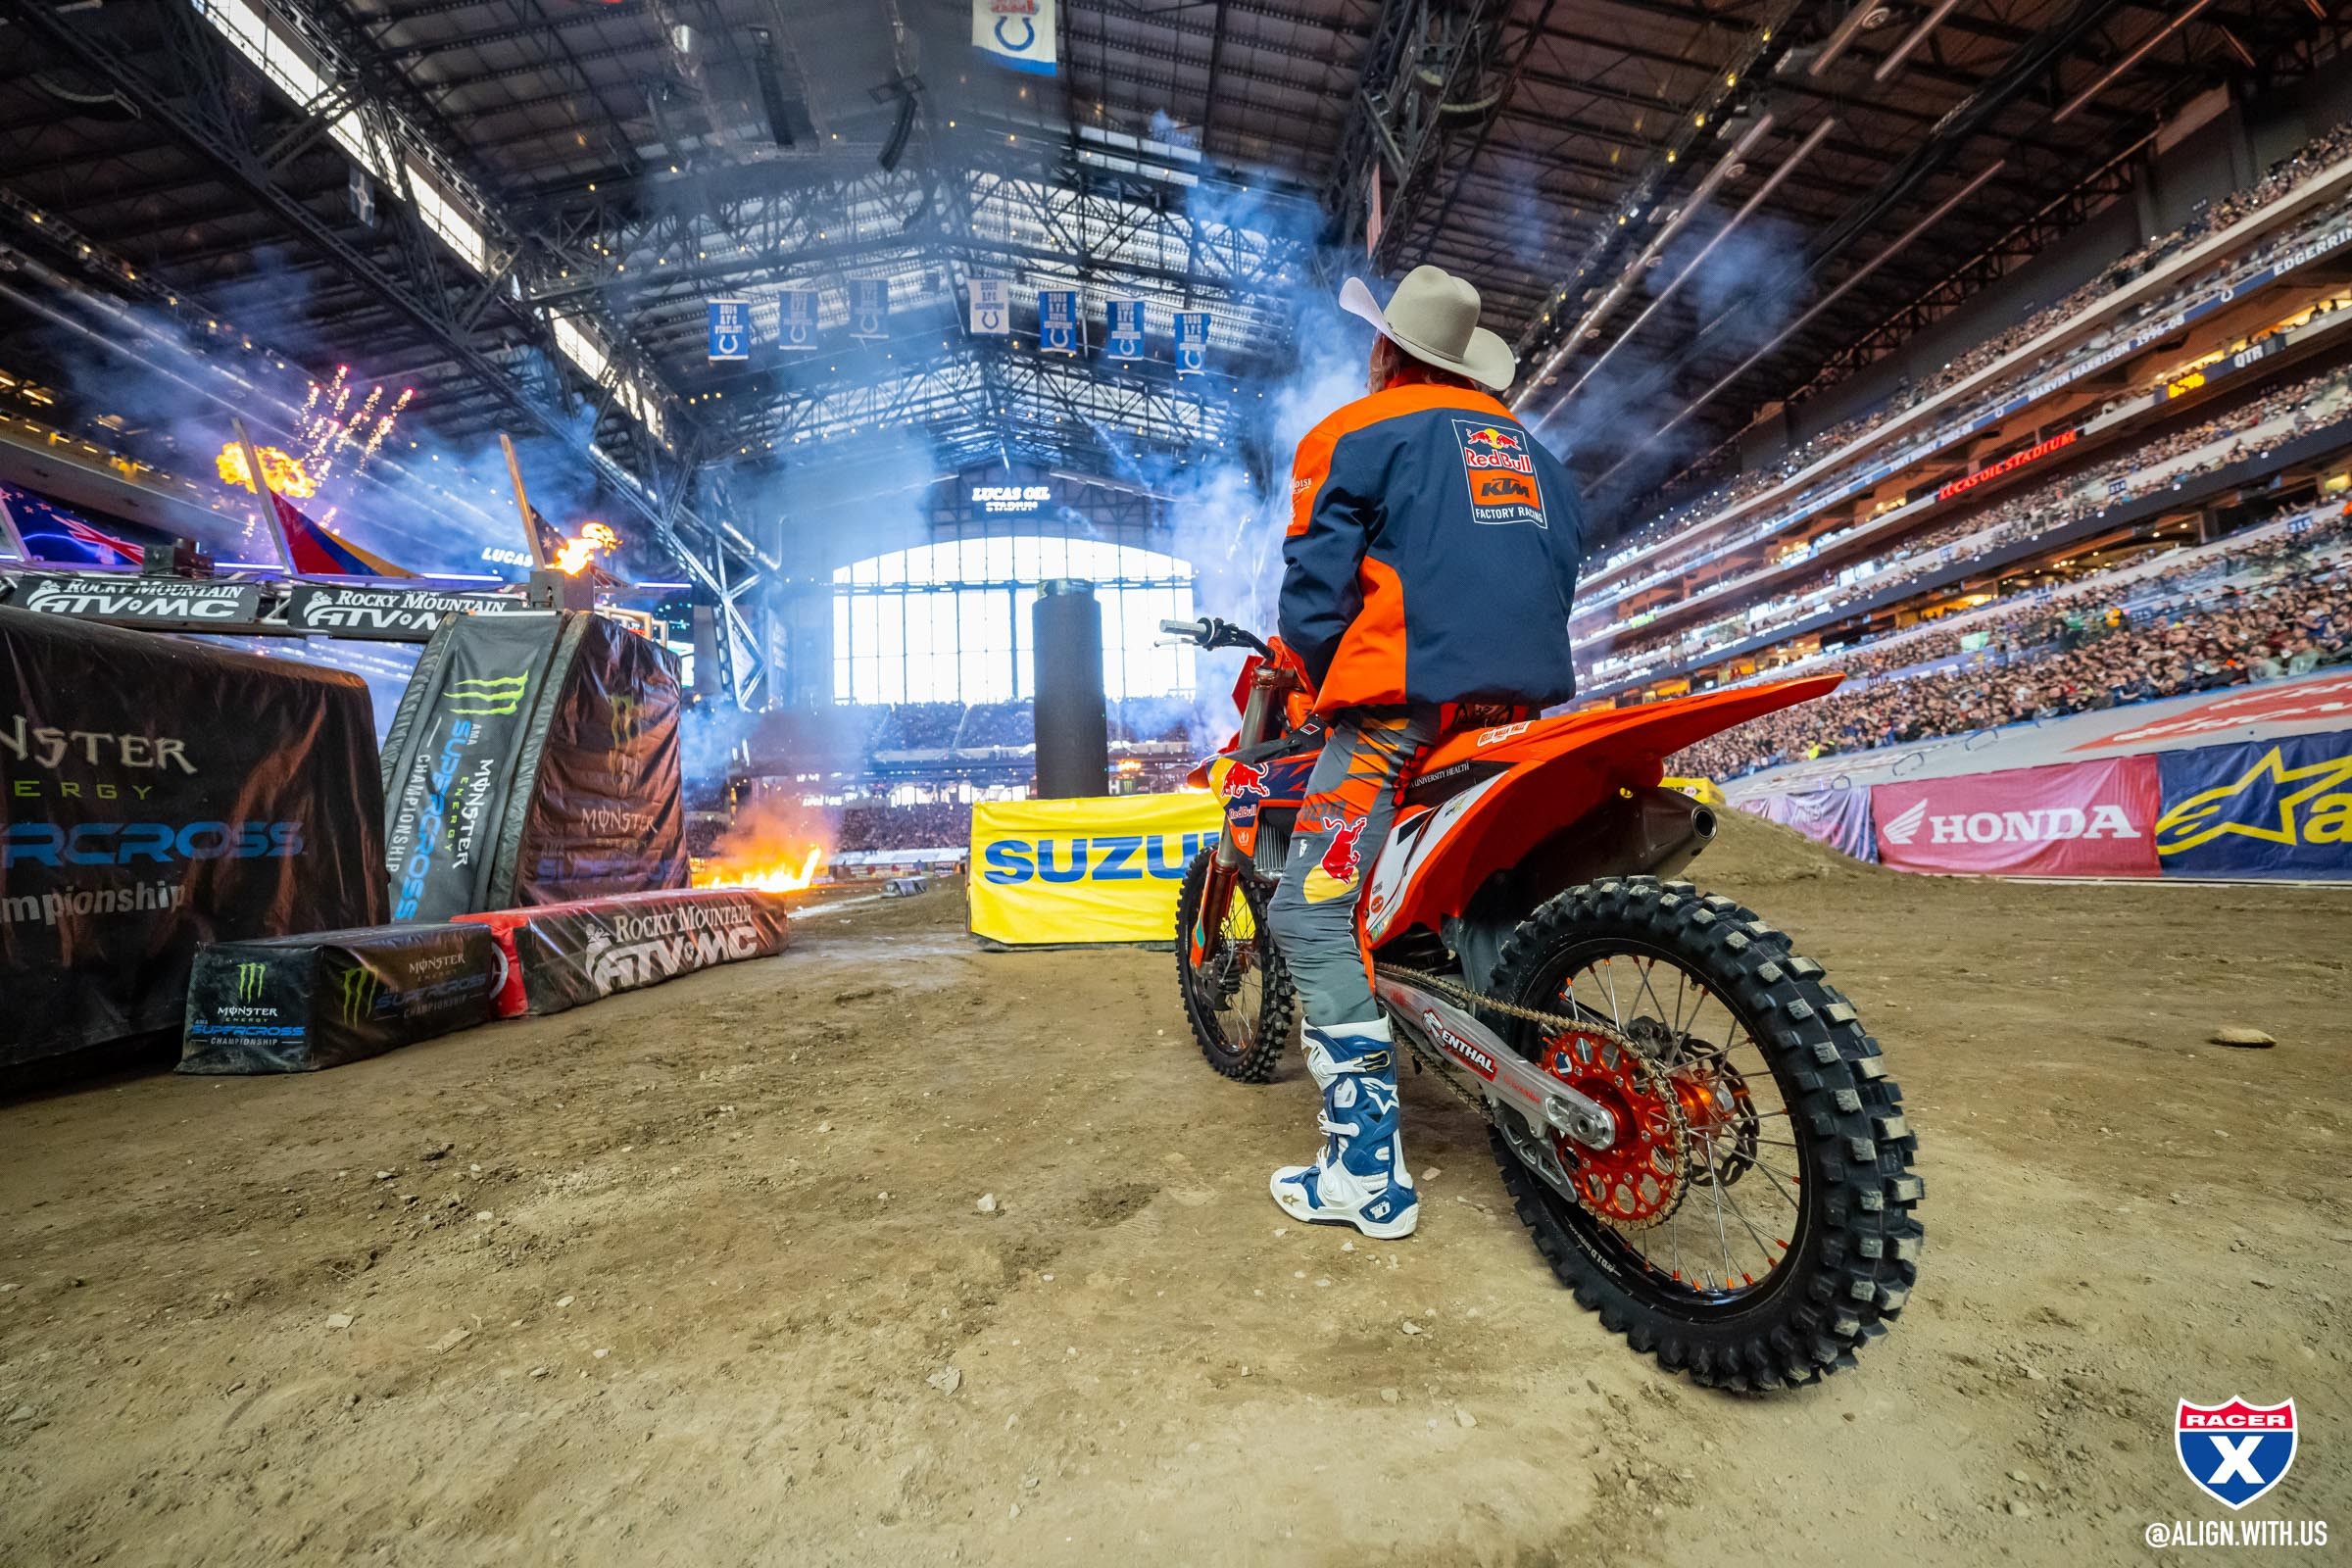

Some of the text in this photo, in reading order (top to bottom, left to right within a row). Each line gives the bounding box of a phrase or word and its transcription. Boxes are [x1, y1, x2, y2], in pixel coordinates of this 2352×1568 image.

[2233, 345, 2264, 368] QTR
[2028, 370, 2071, 402] MARVIN
[2071, 343, 2132, 380] HARRISON
[1937, 472, 1979, 502] LUCAS
[1979, 462, 2003, 482] OIL
[2003, 428, 2077, 471] STADIUM
[971, 486, 1051, 501] LUCAS OIL
[1481, 477, 1530, 499] KTM
[1475, 506, 1544, 523] FACTORY RACING
[481, 546, 534, 568] LUCAS
[64, 580, 245, 599] ROCKY MOUNTAIN
[335, 590, 508, 612] ROCKY MOUNTAIN
[466, 723, 482, 746] AMA
[1413, 769, 1446, 788] UNIVERSITY
[1446, 761, 1470, 777] HEALTH
[386, 755, 431, 873] CHAMPIONSHIP
[394, 718, 471, 921] SUPERCROSS
[445, 776, 469, 853] ENERGY
[452, 759, 494, 869] MONSTER
[581, 807, 658, 833] MONSTER
[1931, 805, 2141, 844] HONDA
[613, 905, 753, 943] ROCKY MOUNTAIN
[409, 953, 466, 974] MONSTER
[218, 1005, 278, 1017] MONSTER
[210, 1037, 278, 1046] CHAMPIONSHIP
